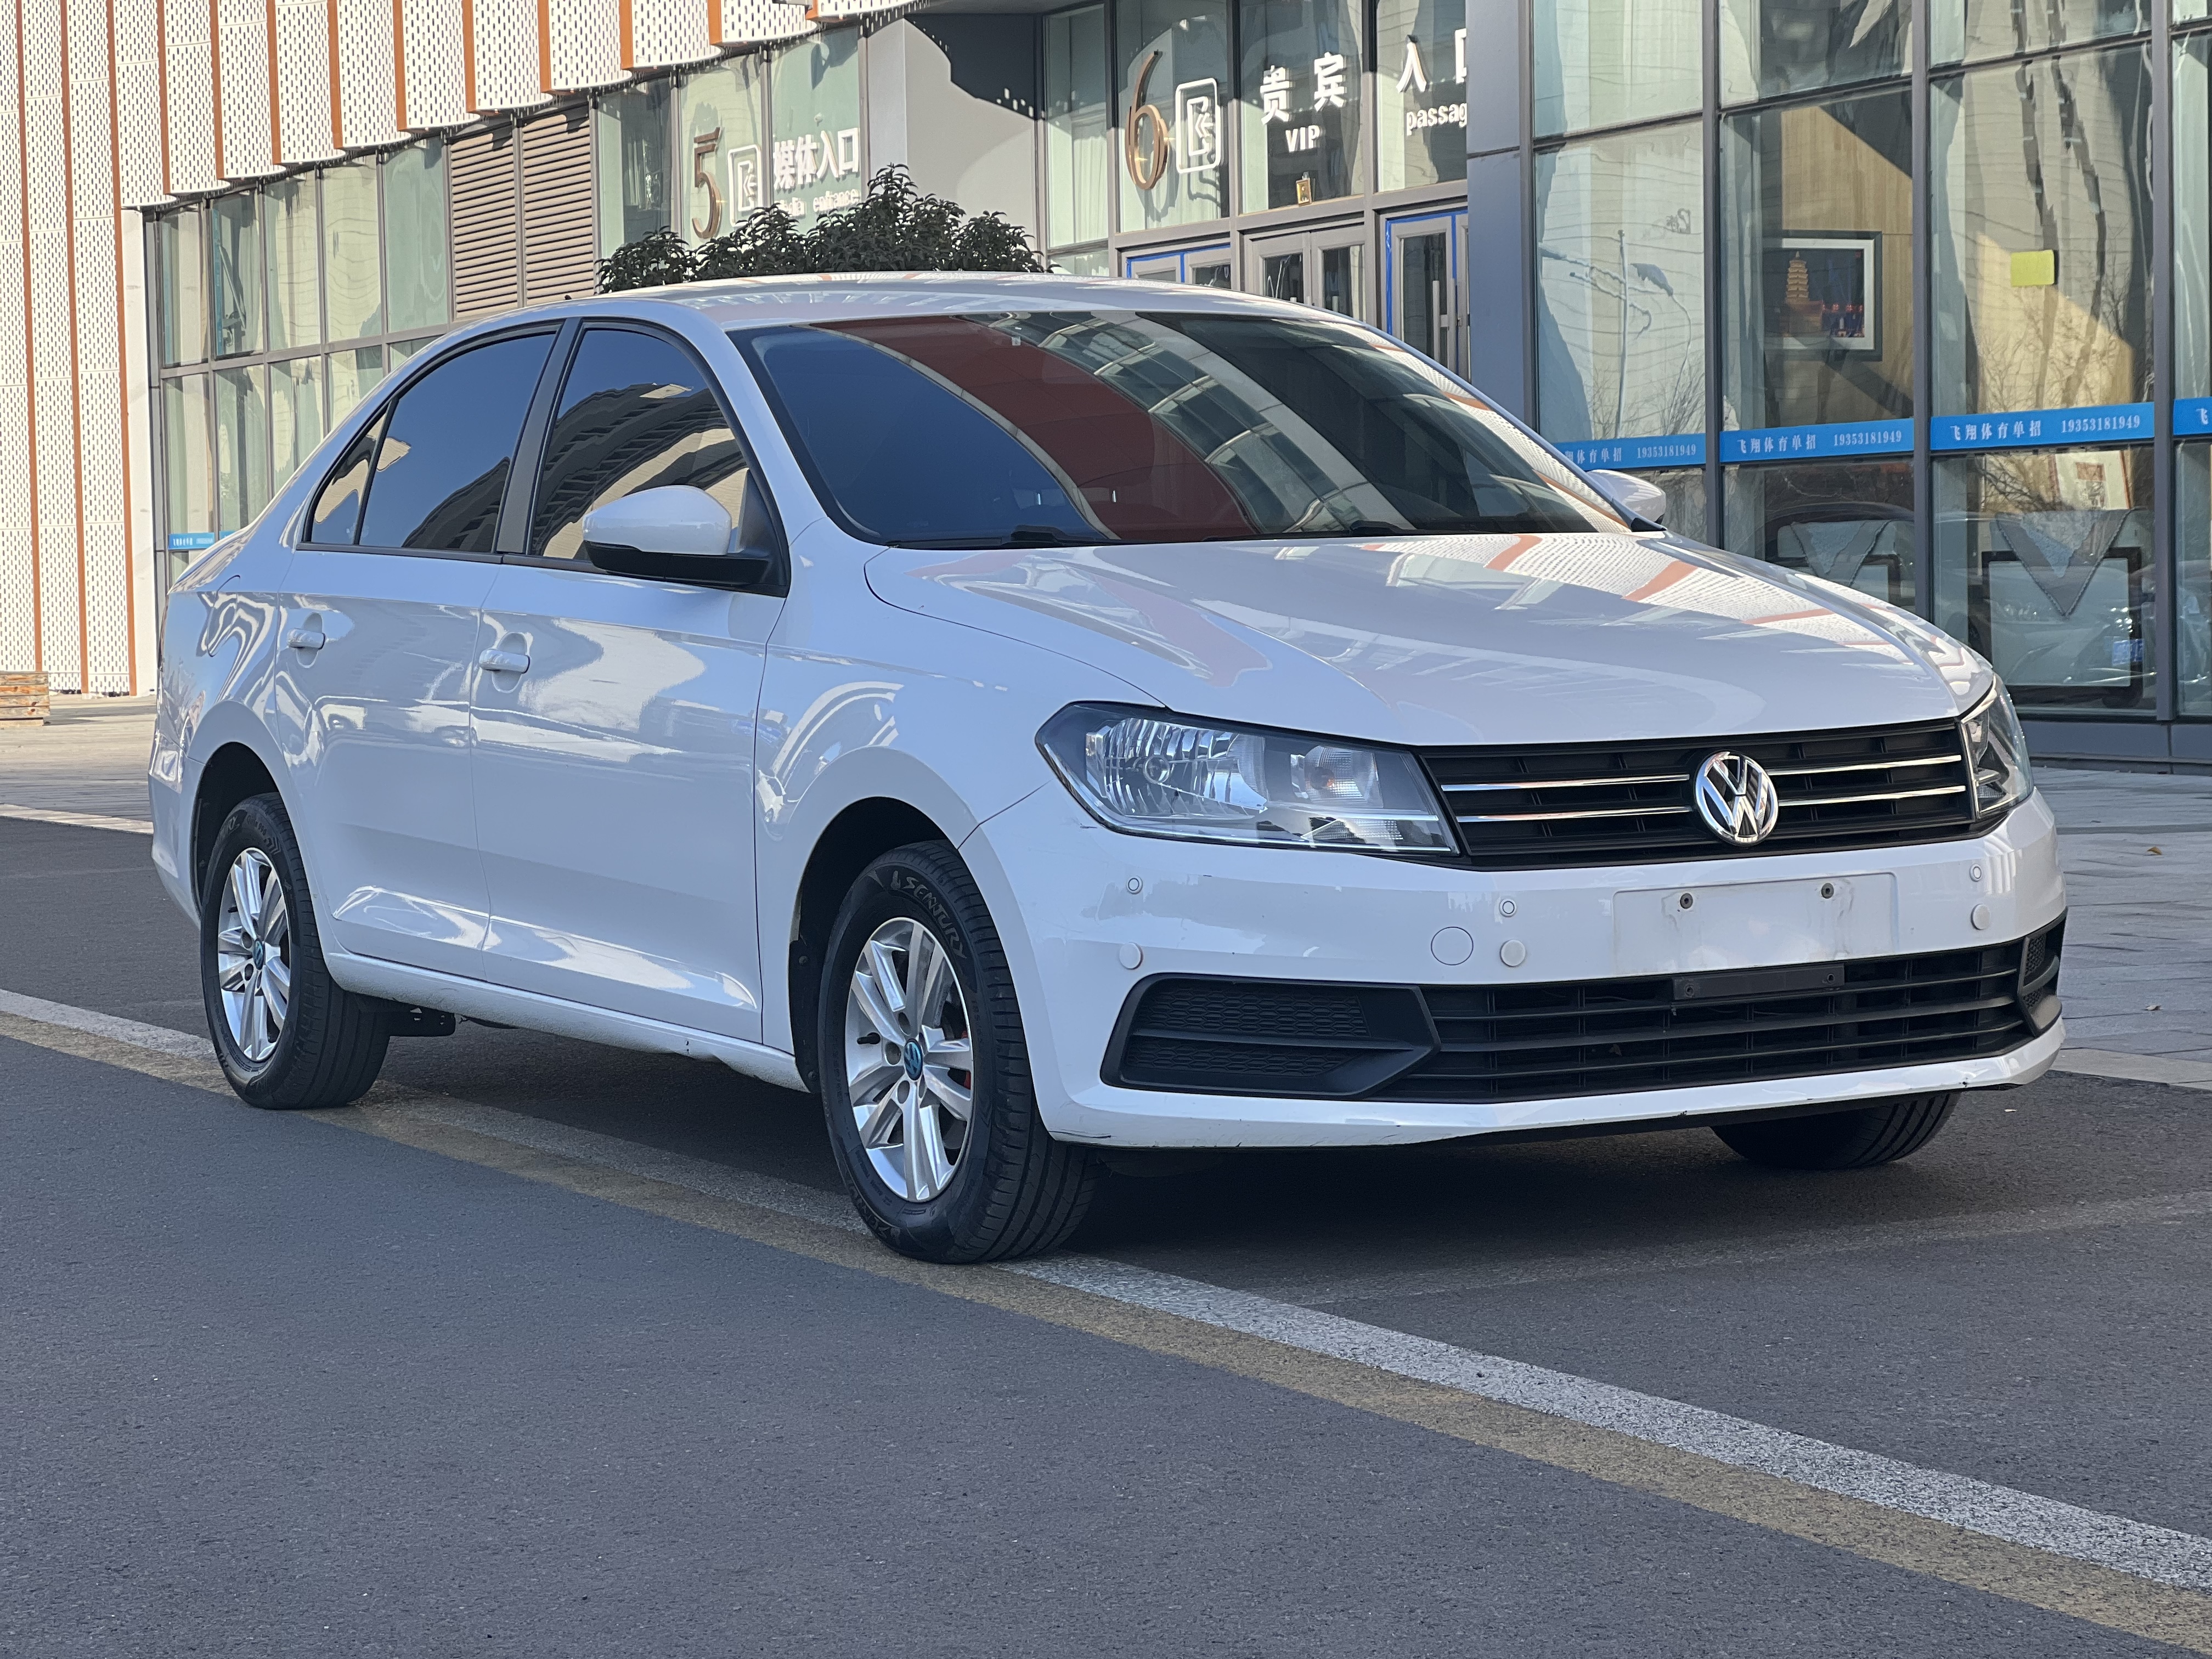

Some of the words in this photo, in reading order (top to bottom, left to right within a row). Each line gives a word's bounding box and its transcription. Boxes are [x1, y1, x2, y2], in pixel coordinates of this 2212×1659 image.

[1260, 51, 1347, 125] 贵宾
[1125, 50, 1169, 190] 6
[1285, 125, 1321, 153] VIP
[772, 127, 860, 190] 媒体入口
[692, 127, 724, 239] 5
[812, 188, 860, 213] entrance
[1736, 433, 1817, 454] 飞翔体育单招
[1833, 430, 1902, 446] 19353181949
[1949, 420, 2042, 441] 飞翔体育单招
[2061, 414, 2140, 433] 19353181949
